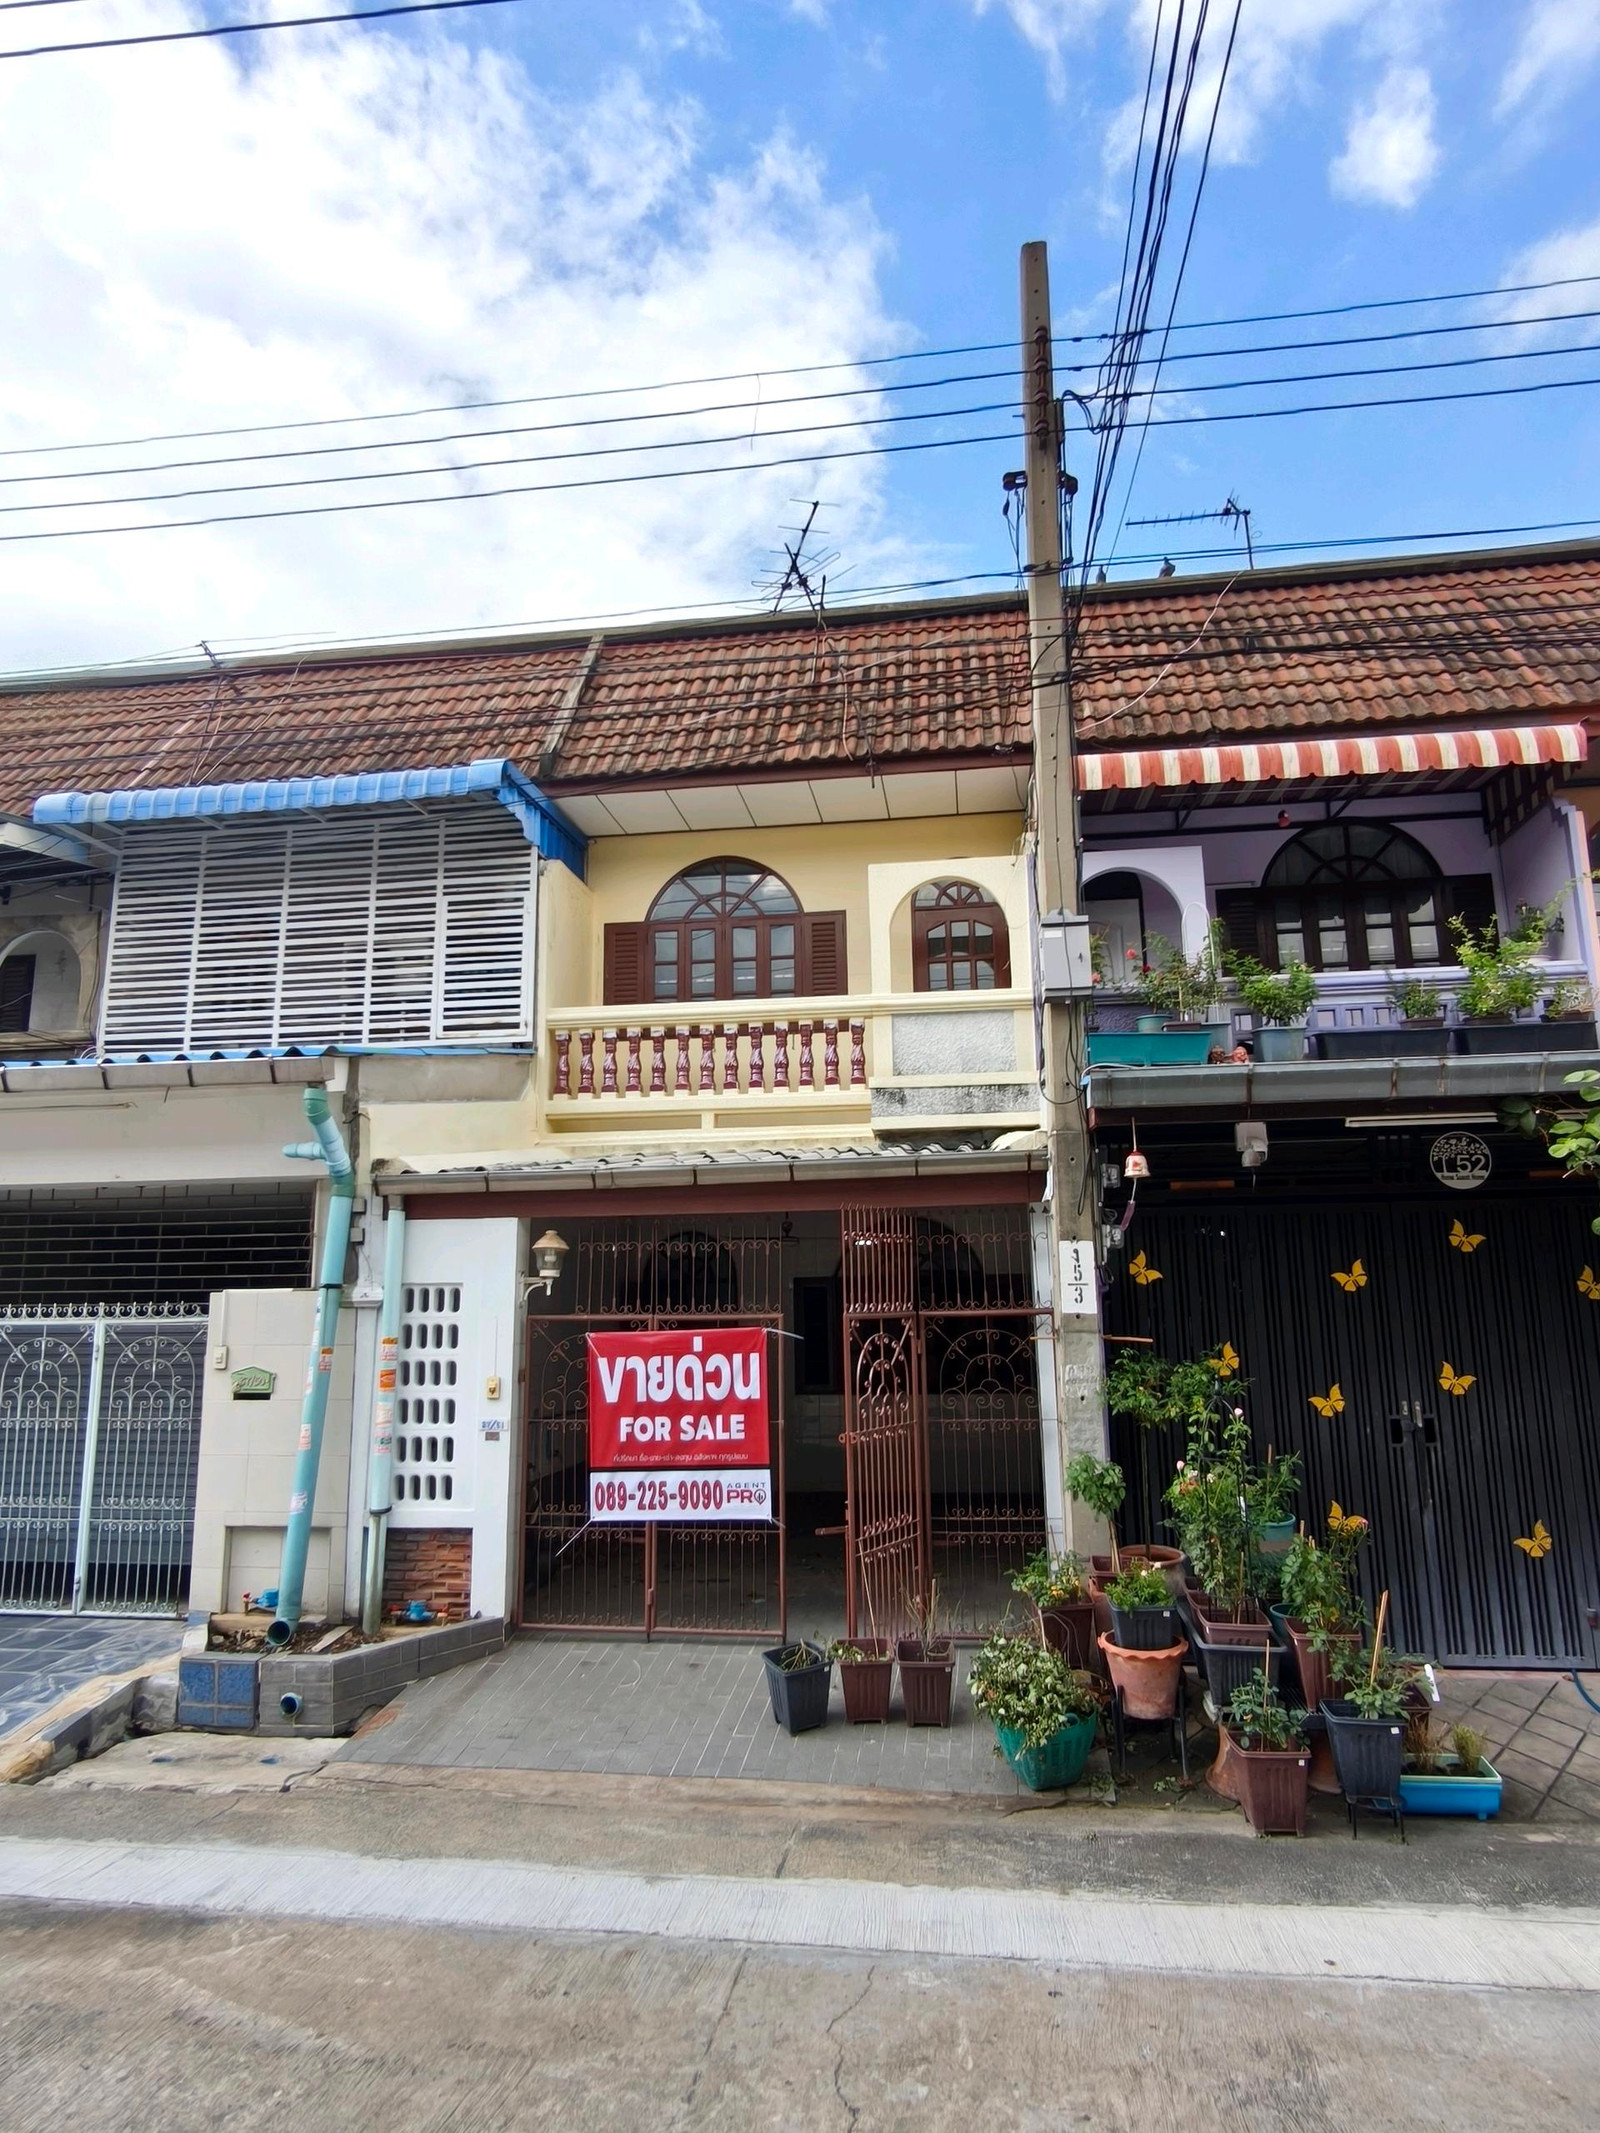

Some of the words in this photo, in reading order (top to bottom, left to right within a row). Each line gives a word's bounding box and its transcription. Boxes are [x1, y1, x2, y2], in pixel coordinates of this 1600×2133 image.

[598, 1336, 761, 1403] ขายด่วน
[619, 1416, 671, 1442] FOR
[680, 1414, 745, 1441] SALE
[594, 1480, 723, 1511] 089-225-9090
